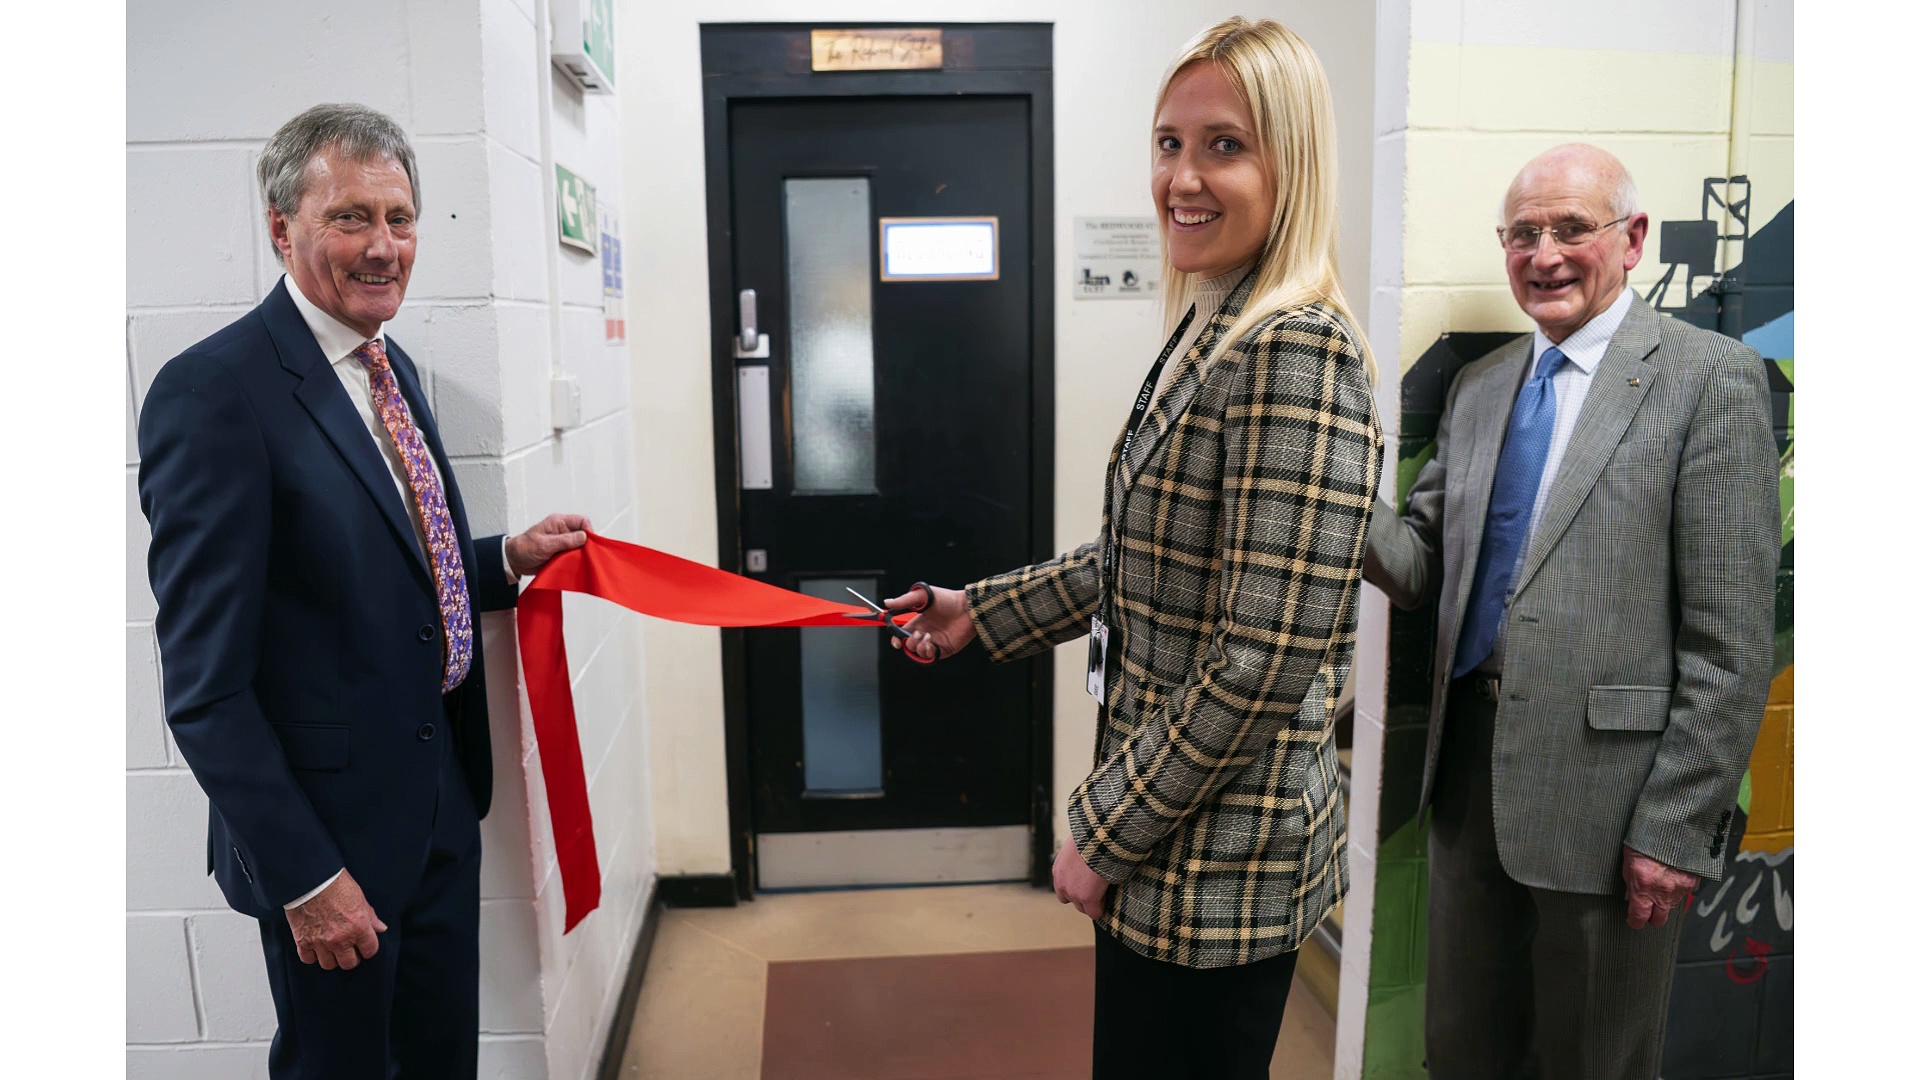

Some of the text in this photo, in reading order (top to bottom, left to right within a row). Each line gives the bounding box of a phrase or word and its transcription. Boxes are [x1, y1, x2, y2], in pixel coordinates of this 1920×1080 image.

[1159, 335, 1178, 365] STAFF
[1136, 381, 1153, 411] STAFF
[1121, 429, 1133, 461] STAFF
